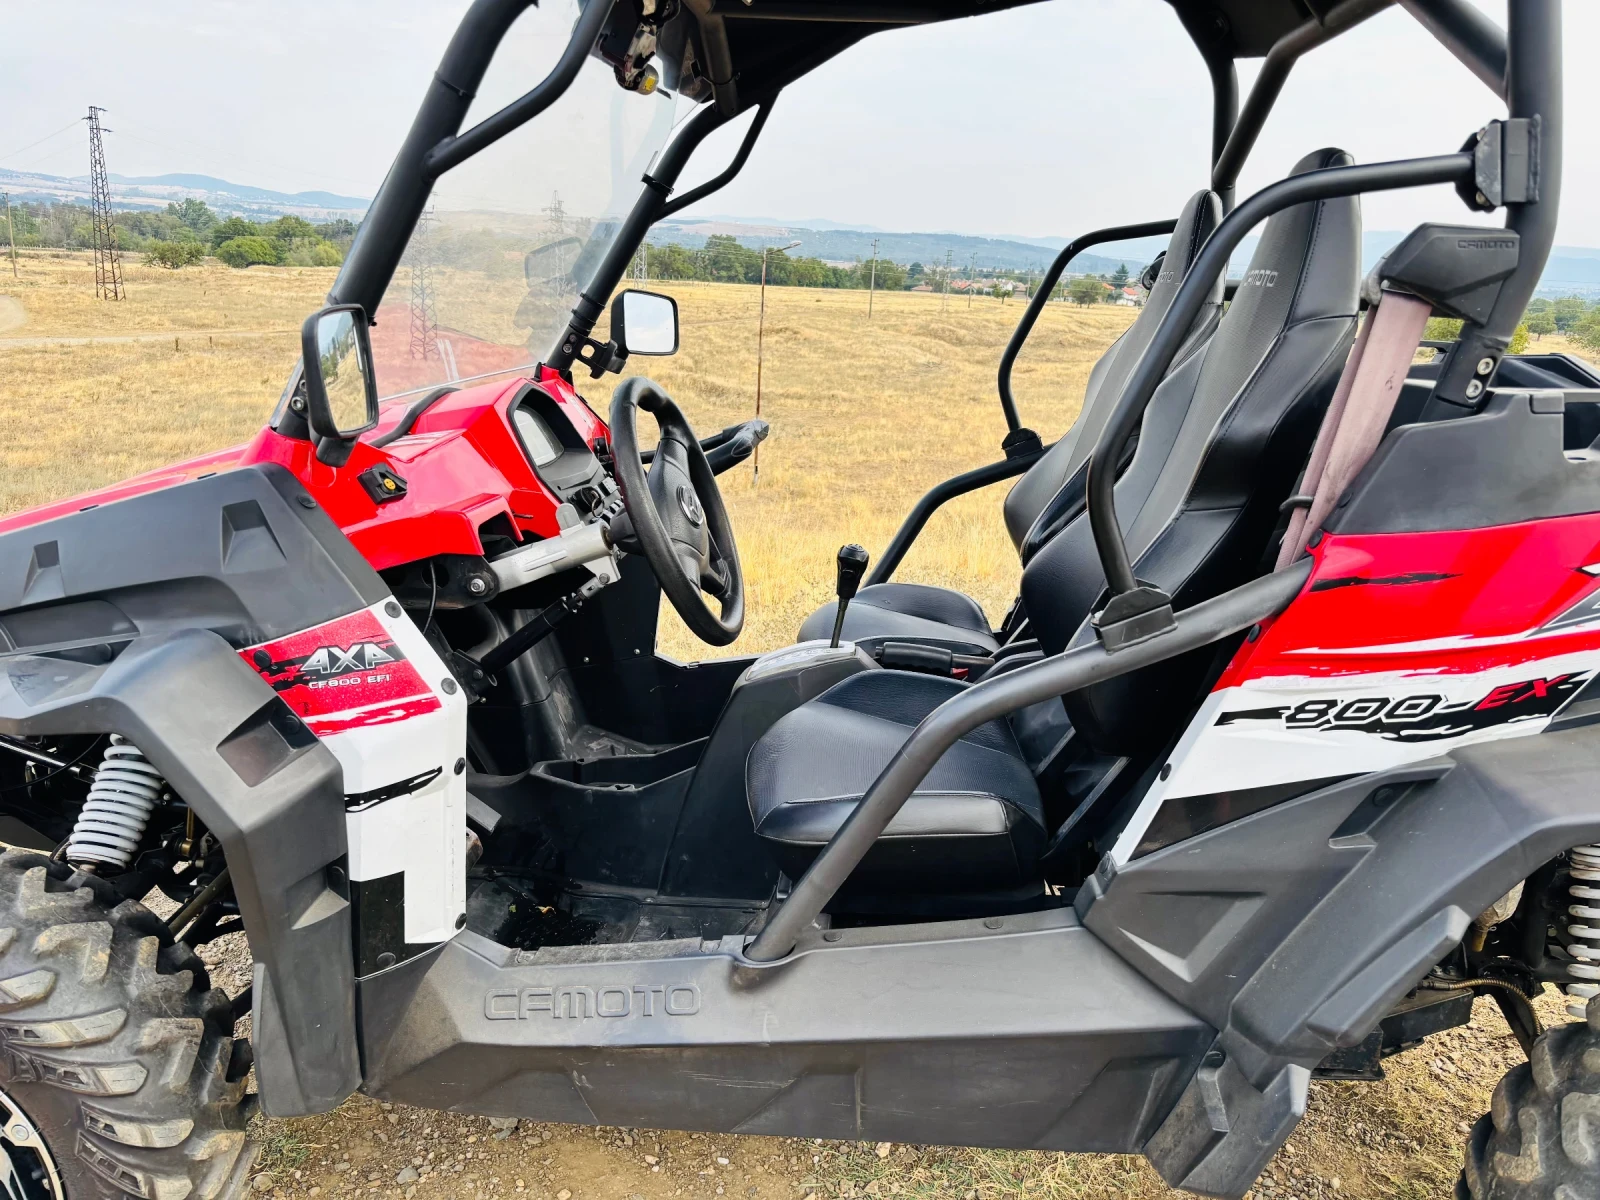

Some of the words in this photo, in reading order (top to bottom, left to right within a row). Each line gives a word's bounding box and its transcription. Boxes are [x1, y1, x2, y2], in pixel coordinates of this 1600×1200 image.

[1457, 240, 1516, 250] CFMOTO
[308, 676, 361, 690] CF800
[367, 674, 391, 684] EFI
[1284, 694, 1445, 729] 800
[1474, 674, 1570, 711] EX
[484, 984, 701, 1021] CFMOTO
